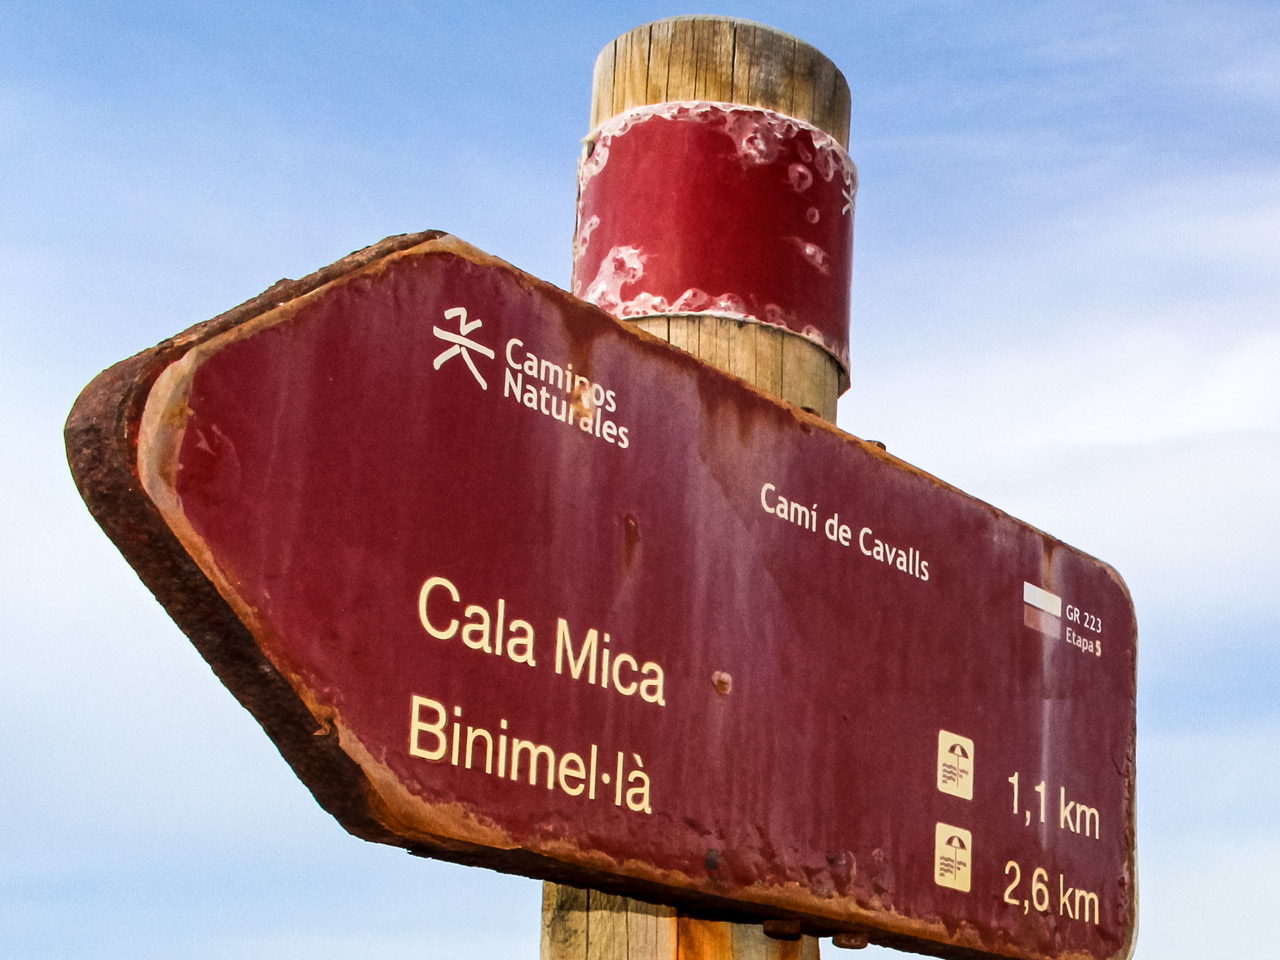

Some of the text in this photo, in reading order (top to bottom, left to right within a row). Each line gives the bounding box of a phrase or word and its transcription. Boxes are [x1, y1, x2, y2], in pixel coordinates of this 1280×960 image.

[503, 366, 630, 449] Naturales
[760, 482, 930, 582] Camí de Cavalls
[418, 576, 666, 707] Cala Mica
[1065, 626, 1102, 657] Etapa 5
[1066, 604, 1102, 633] GR 223
[1008, 771, 1100, 840] 1,1 km
[1003, 860, 1100, 925] 2,6 km
